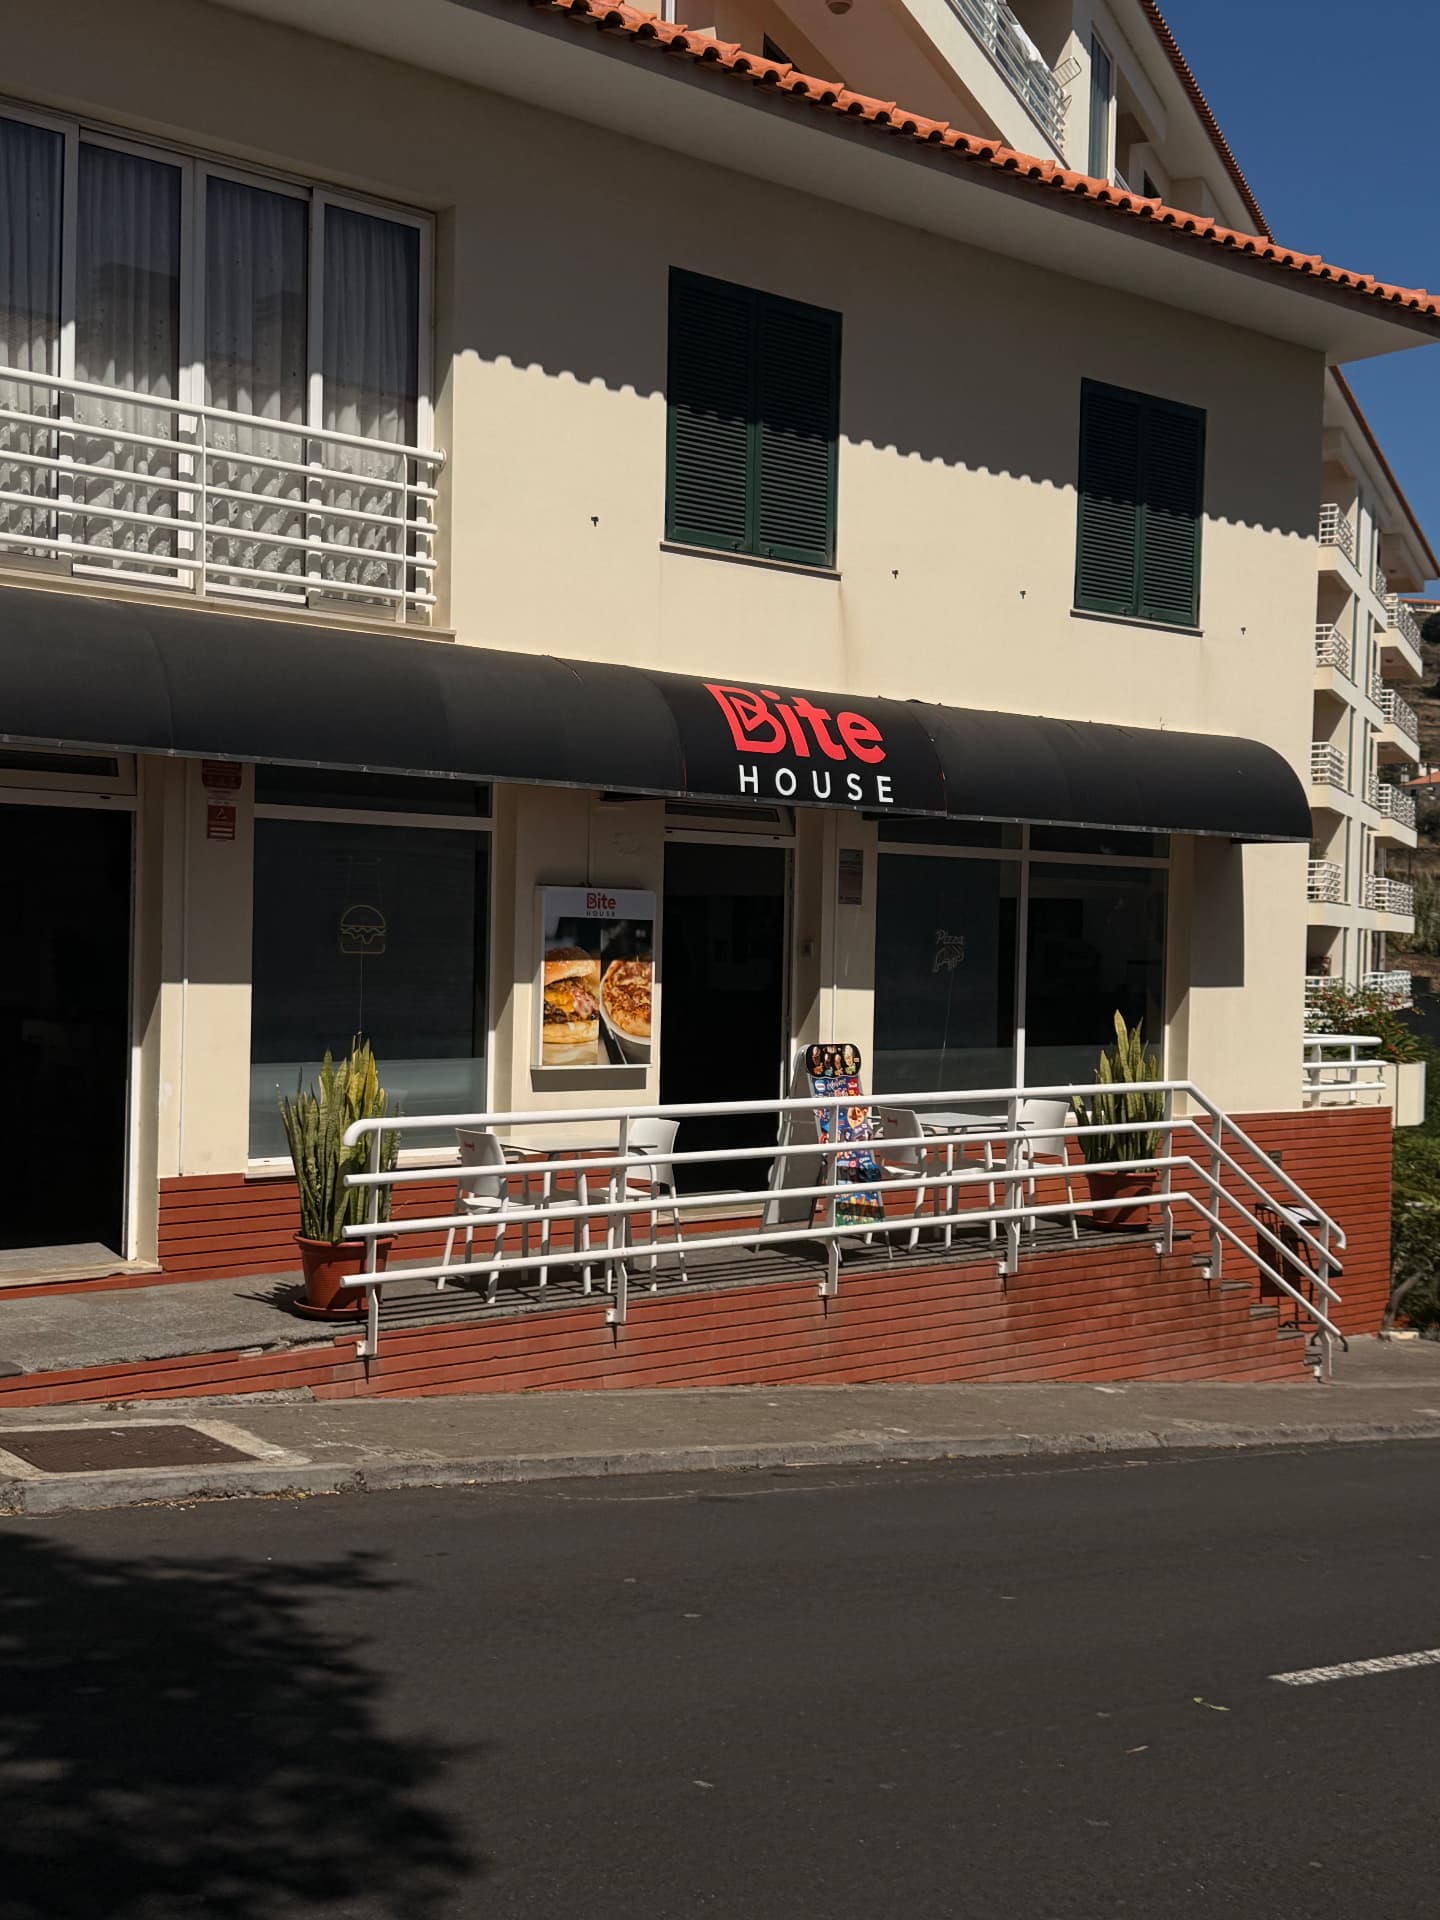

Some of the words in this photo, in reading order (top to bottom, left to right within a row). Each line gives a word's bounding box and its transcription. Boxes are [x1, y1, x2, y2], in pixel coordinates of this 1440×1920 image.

[703, 683, 887, 764] Bite
[738, 764, 894, 803] HOUSE
[586, 892, 616, 910] Bite
